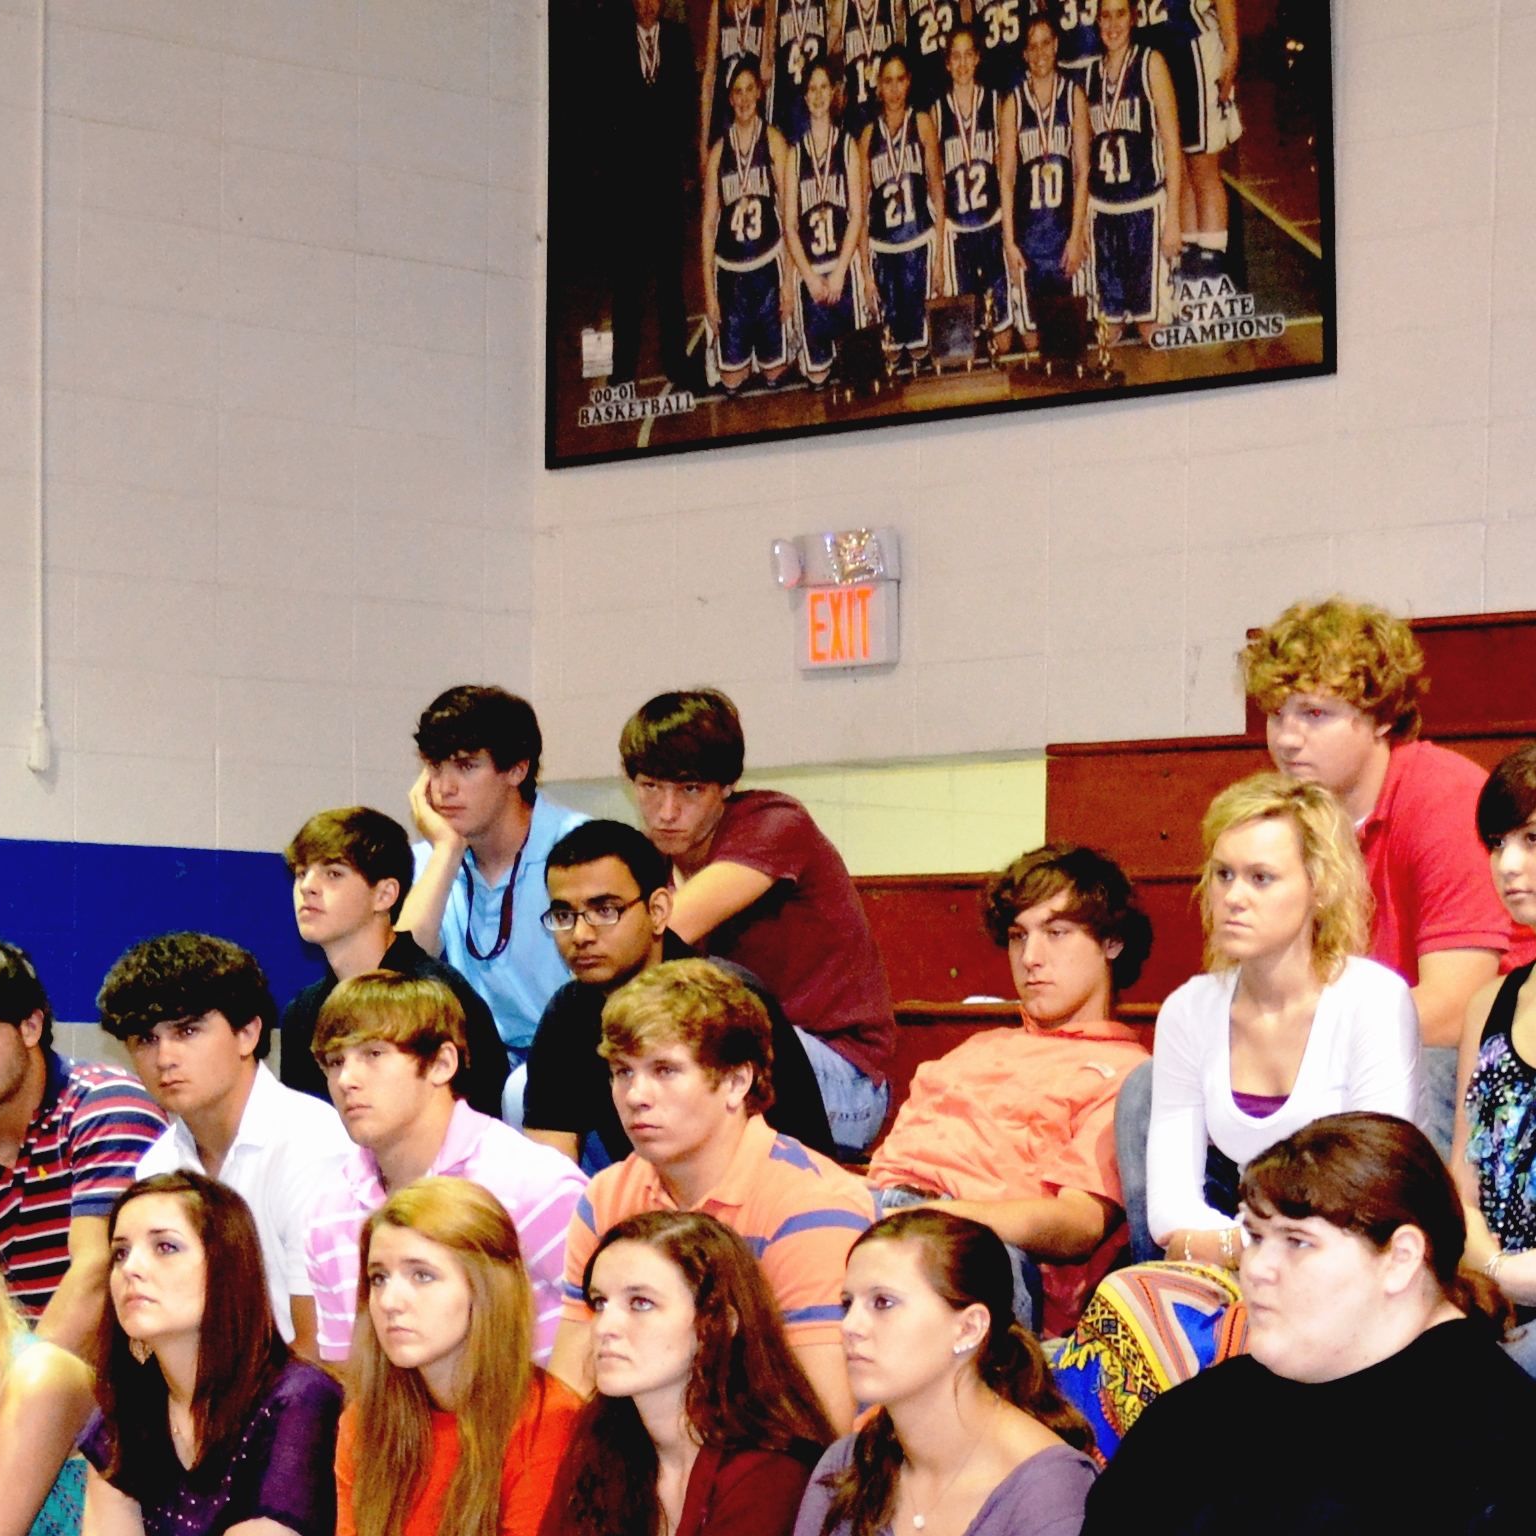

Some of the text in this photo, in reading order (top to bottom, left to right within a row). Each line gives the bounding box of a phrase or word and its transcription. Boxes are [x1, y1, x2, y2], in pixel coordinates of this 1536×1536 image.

[984, 1, 1020, 48] 35
[1099, 135, 1131, 184] 41
[883, 178, 916, 228] 21
[955, 164, 988, 214] 12
[1030, 163, 1063, 209] 10
[730, 197, 763, 242] 43
[809, 208, 837, 256] 31
[1179, 277, 1234, 301] AAA
[1180, 296, 1254, 323] STATE
[1150, 315, 1284, 349] CHAMPIONS
[580, 393, 695, 426] BASKETBALL
[808, 586, 874, 664] EXIT
